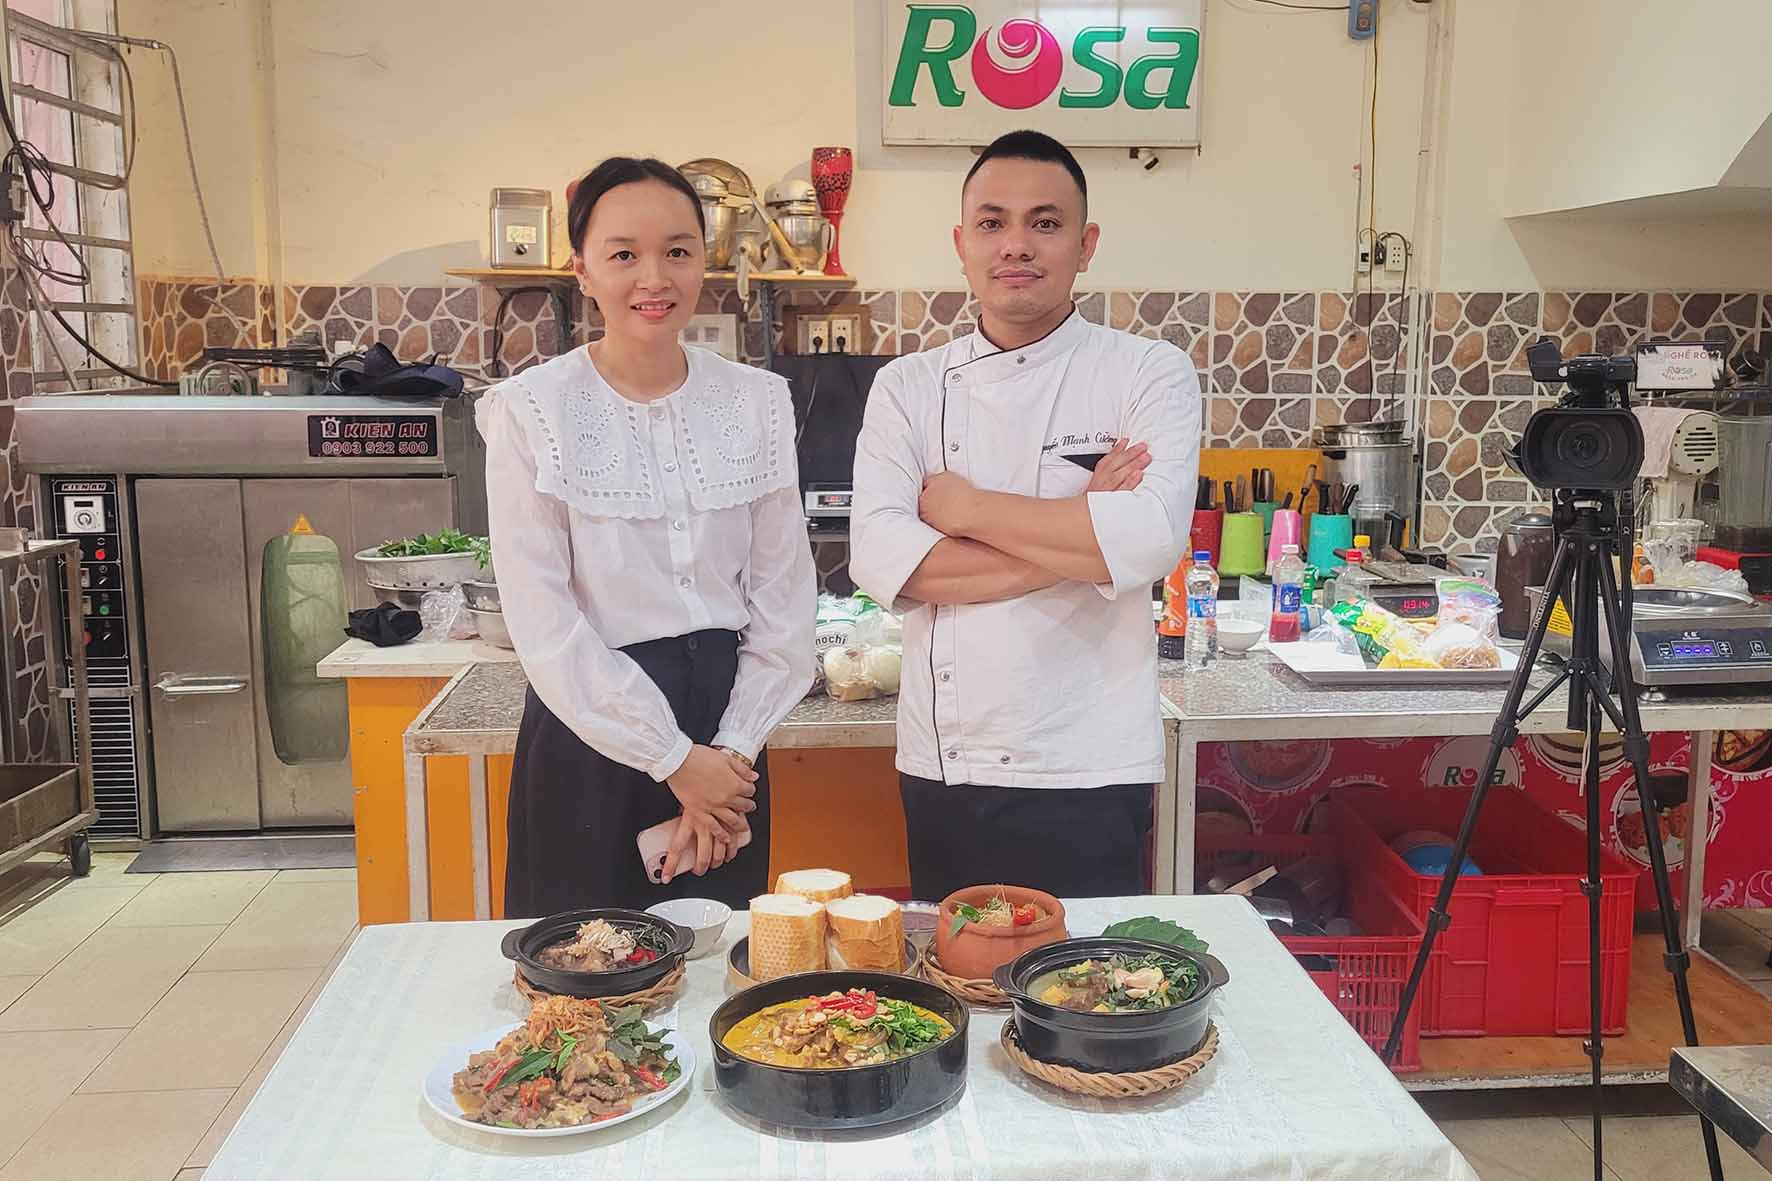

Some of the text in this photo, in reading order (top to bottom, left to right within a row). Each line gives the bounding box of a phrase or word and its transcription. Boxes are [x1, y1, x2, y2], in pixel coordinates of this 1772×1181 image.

[888, 3, 1201, 110] Rosa
[344, 422, 428, 438] KIEN AN
[321, 441, 428, 454] 0903 922 500
[1442, 766, 1505, 785] Roa
